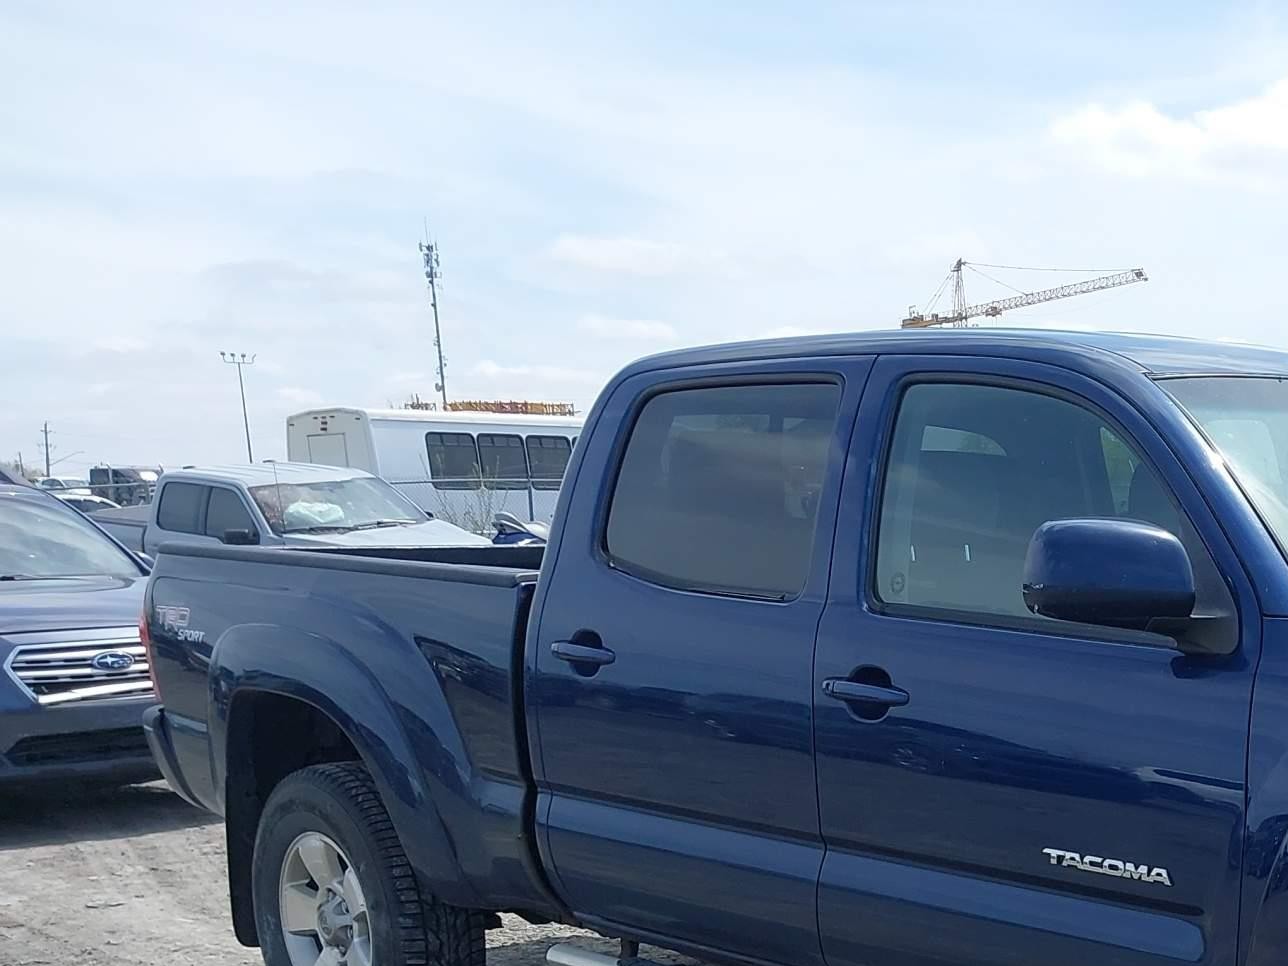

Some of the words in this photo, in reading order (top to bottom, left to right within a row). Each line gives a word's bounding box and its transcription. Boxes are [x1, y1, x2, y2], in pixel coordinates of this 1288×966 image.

[155, 605, 191, 631] TRD
[177, 628, 206, 643] SPORT
[1042, 847, 1173, 886] TACOMA
